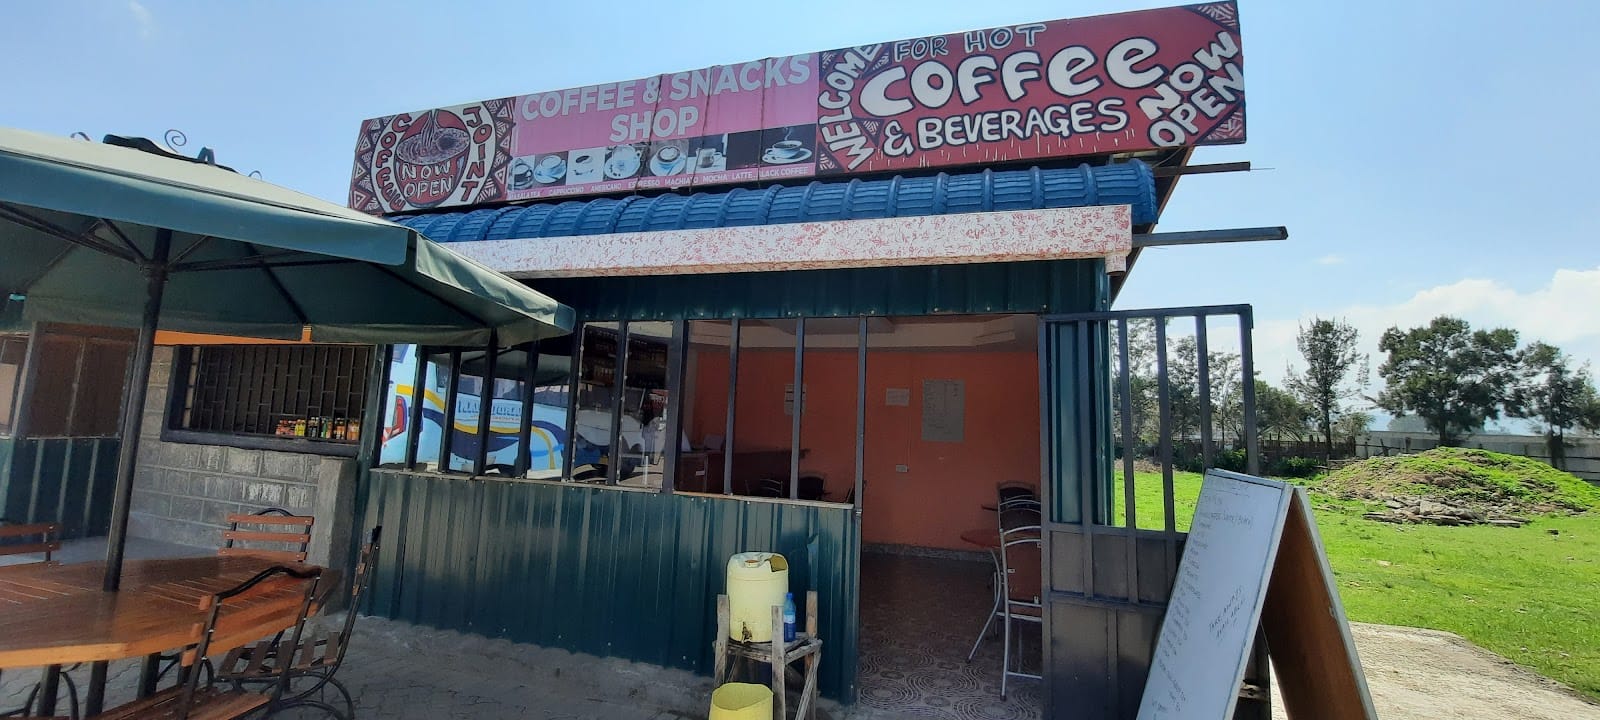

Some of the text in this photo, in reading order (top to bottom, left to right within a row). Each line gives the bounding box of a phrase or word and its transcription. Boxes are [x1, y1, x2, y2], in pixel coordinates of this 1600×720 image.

[894, 23, 1047, 61] FOR HOT
[521, 55, 811, 121] COFFEE & SNACKS
[1139, 30, 1239, 121] NOW
[609, 106, 699, 143] SHOP
[818, 42, 881, 170] WELCOME
[883, 98, 1129, 156] & BEVERAGES
[1149, 62, 1245, 148] OPEN
[375, 112, 413, 206] COFFEE
[401, 161, 451, 181] NOW
[462, 106, 493, 201] JOINT
[702, 174, 728, 183] MOCHA
[780, 166, 809, 176] COFFEE
[403, 175, 453, 199] OPEN
